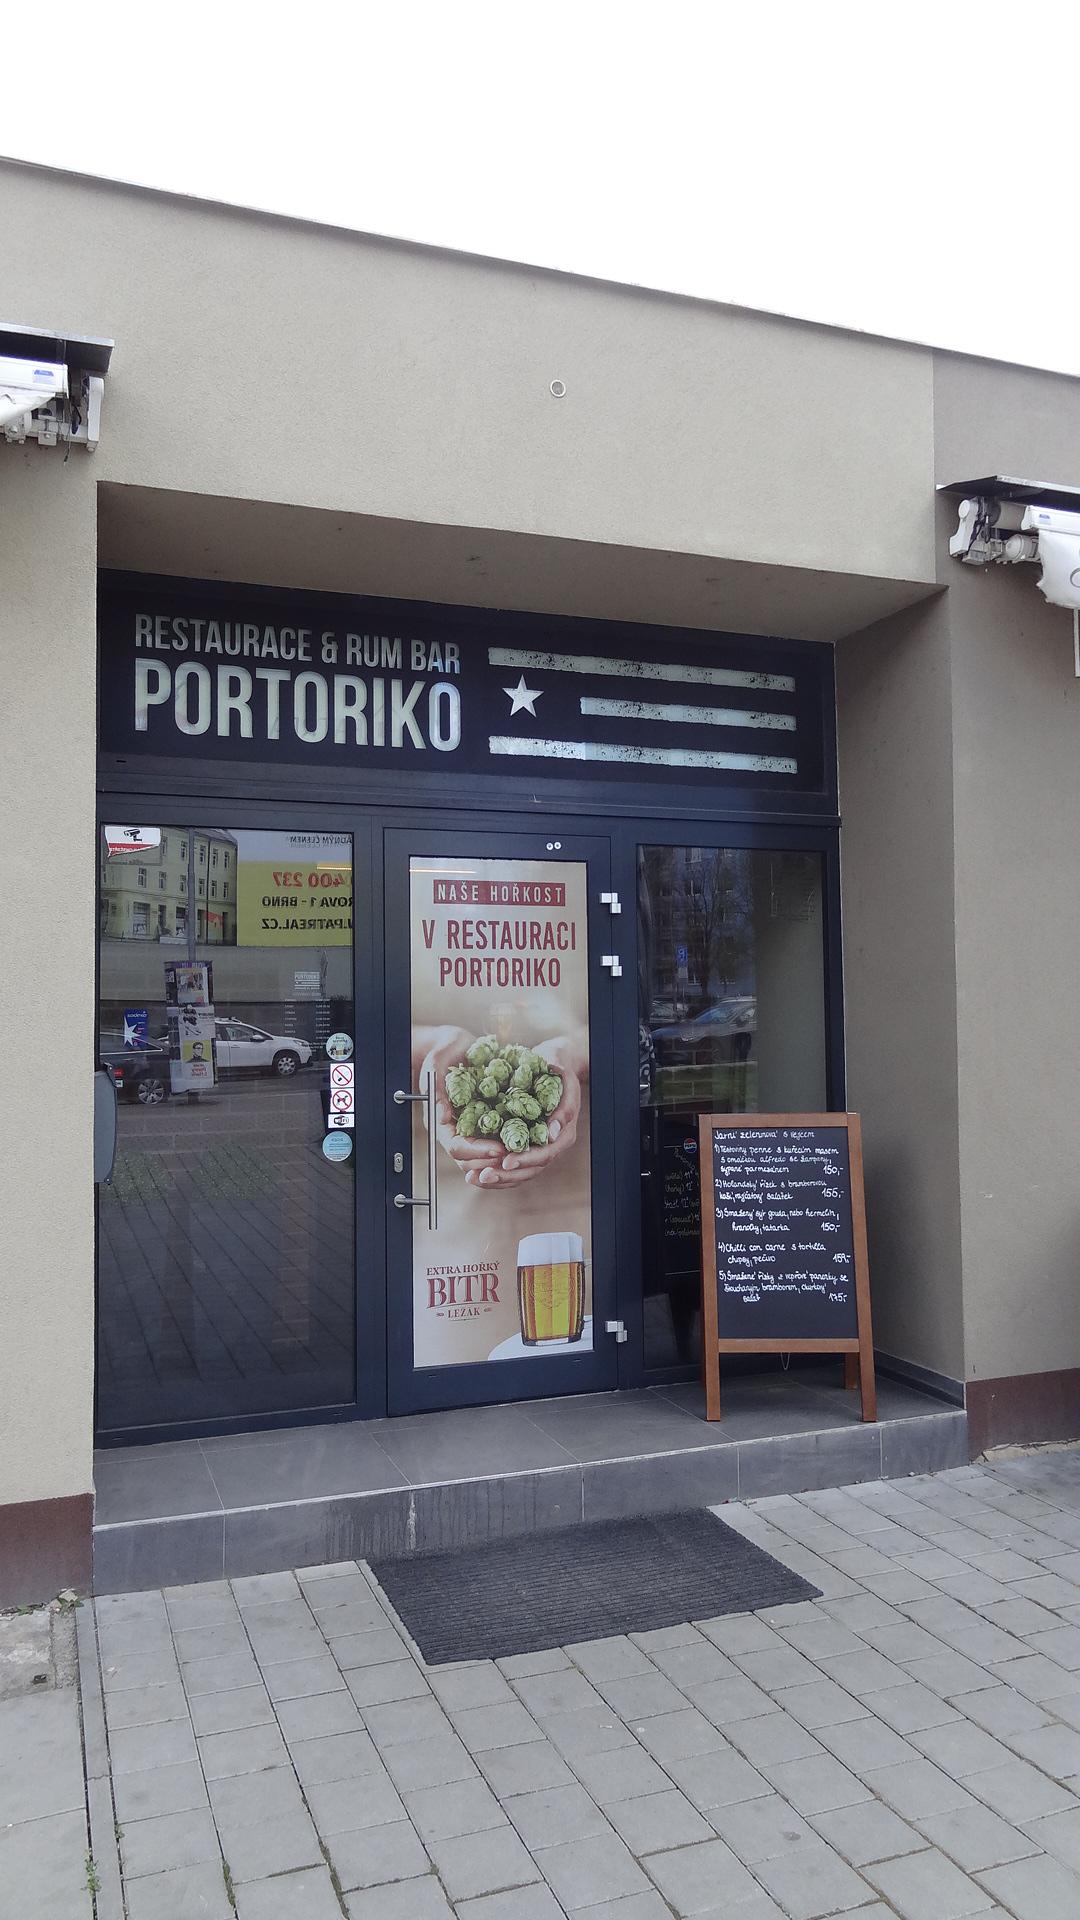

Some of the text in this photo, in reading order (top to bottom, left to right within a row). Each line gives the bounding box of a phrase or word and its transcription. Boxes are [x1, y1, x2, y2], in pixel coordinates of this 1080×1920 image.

[135, 613, 461, 674] RESTAURACE & RUM BAR
[134, 656, 461, 752] PORTORIKO
[438, 881, 562, 903] NAŠE HOŘKOST
[421, 919, 576, 951] V RESTAURACI
[439, 956, 561, 987] PORTORIKO
[426, 1261, 500, 1276] EXTRA HOŘKÝ
[426, 1272, 501, 1308] BITR
